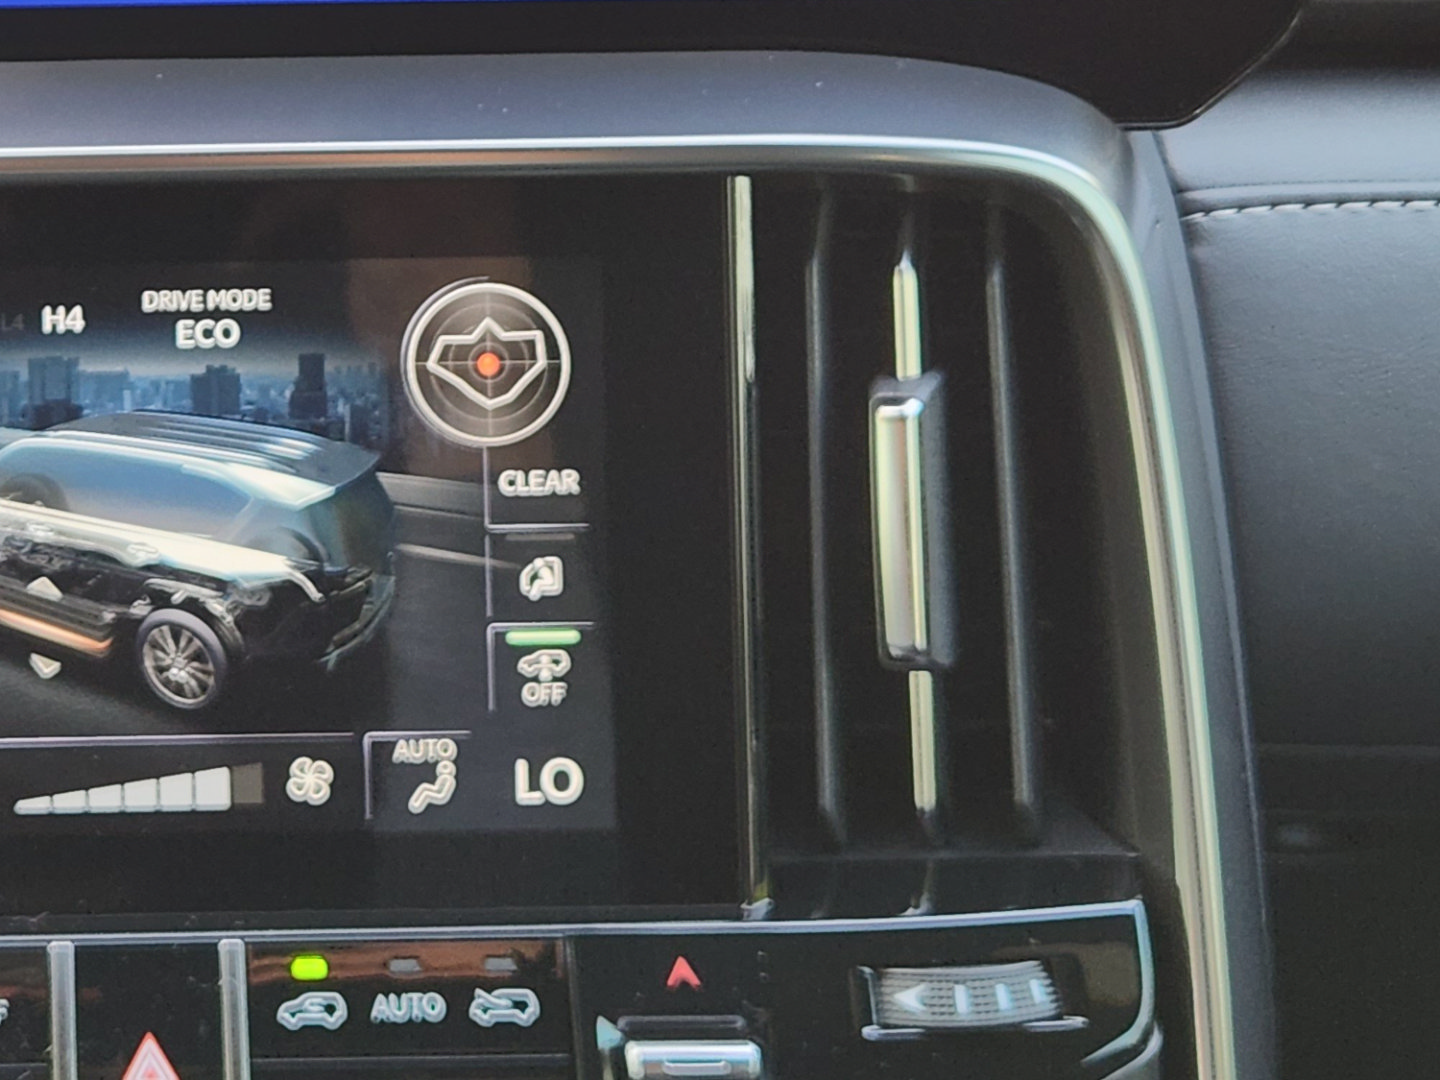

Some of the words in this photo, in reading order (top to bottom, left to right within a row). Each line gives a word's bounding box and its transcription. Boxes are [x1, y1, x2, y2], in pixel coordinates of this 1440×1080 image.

[141, 289, 204, 313] DRIVE
[206, 288, 273, 311] MODE
[41, 304, 86, 335] H4
[175, 318, 241, 349] ECO
[497, 469, 581, 496] CLEAR
[521, 681, 568, 706] OFF
[392, 738, 457, 764] AUTO
[514, 757, 584, 806] LO
[370, 991, 447, 1023] AUTO
